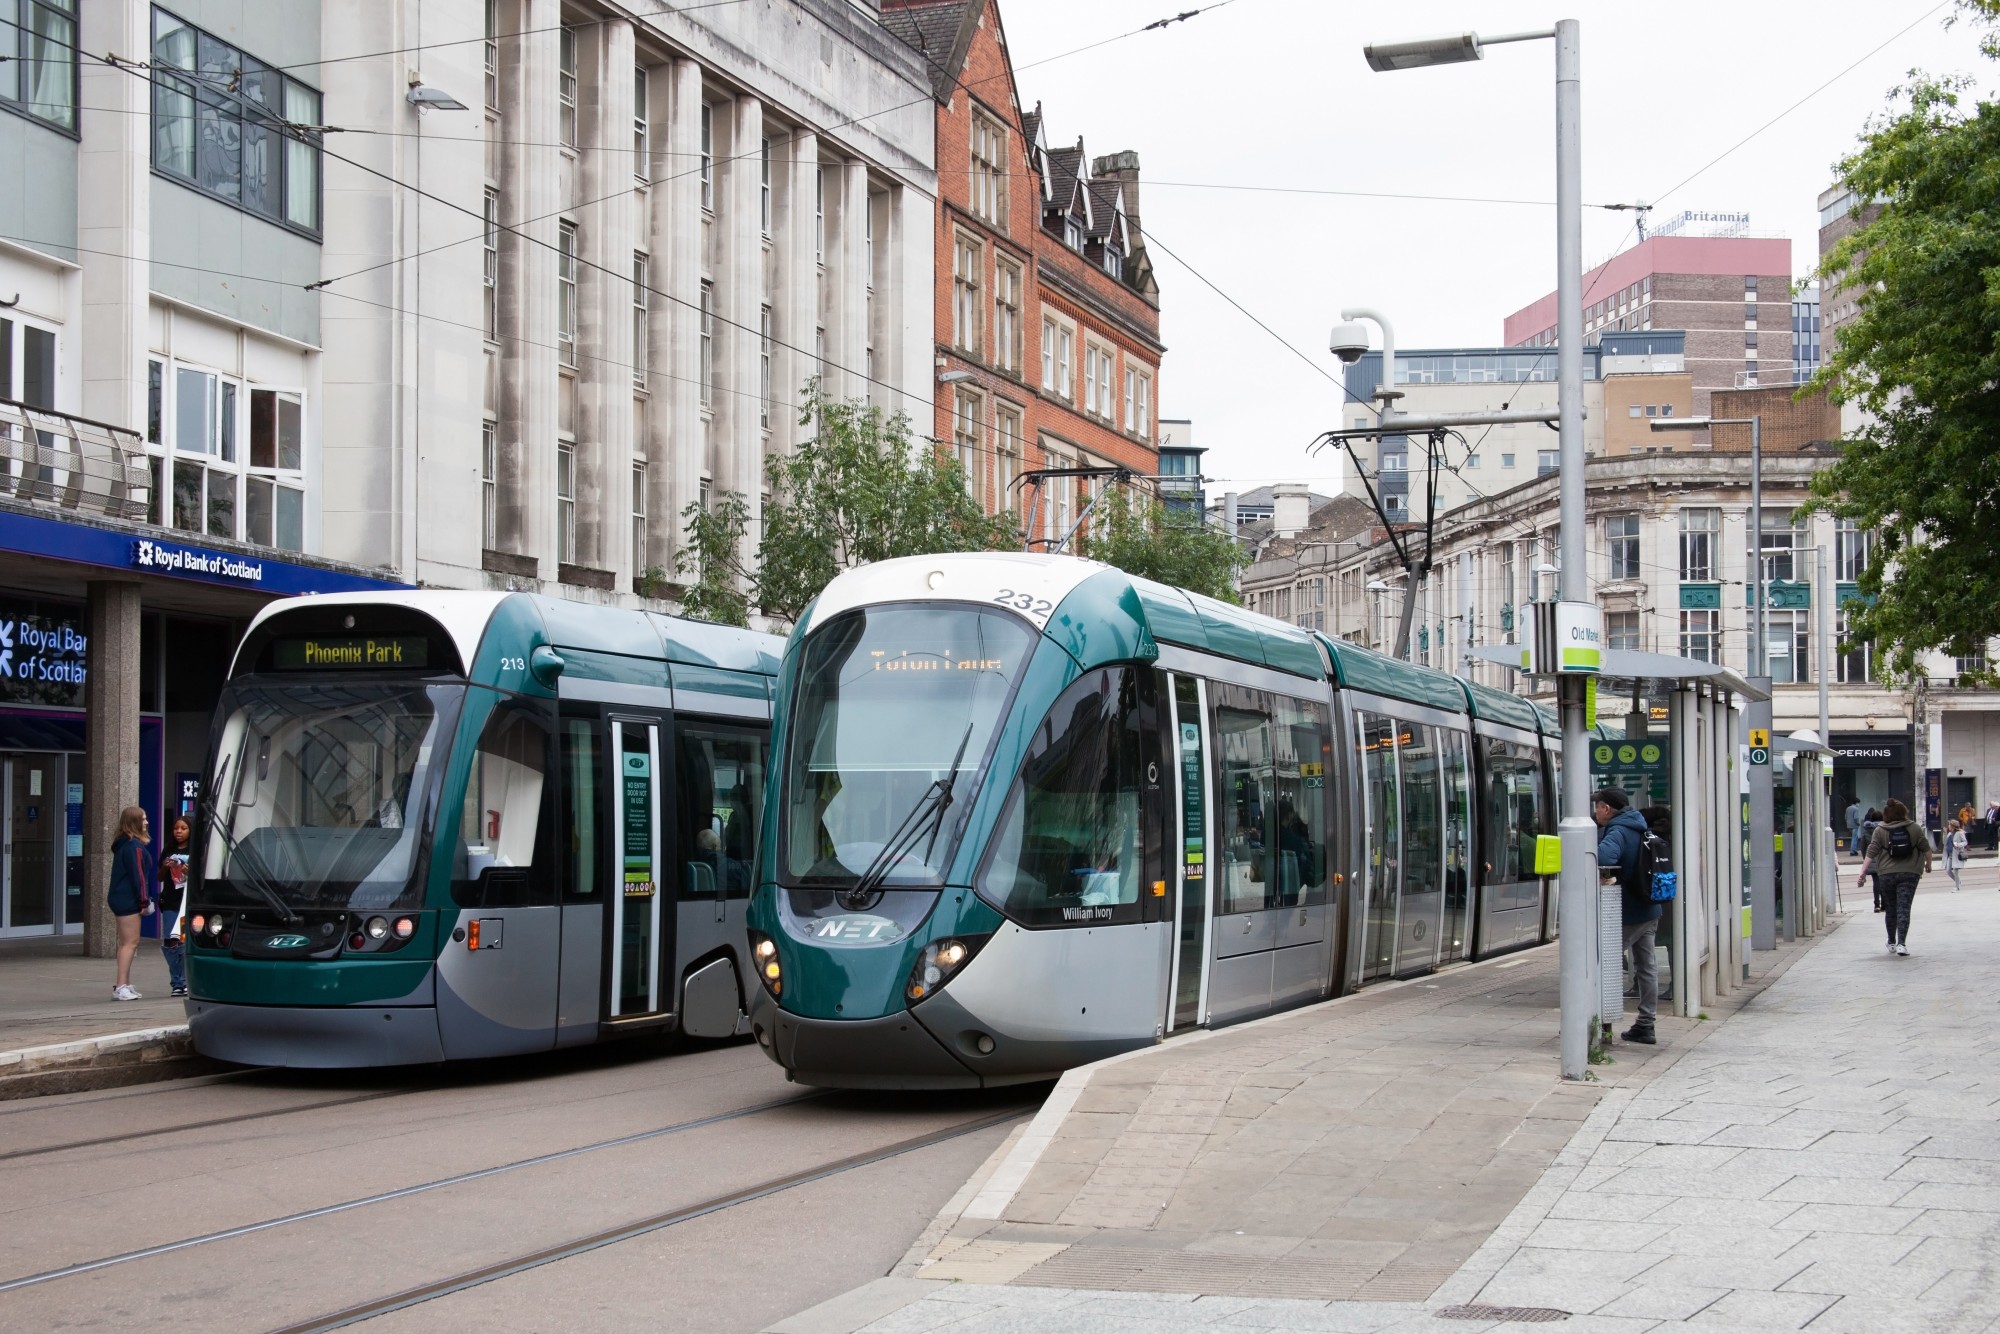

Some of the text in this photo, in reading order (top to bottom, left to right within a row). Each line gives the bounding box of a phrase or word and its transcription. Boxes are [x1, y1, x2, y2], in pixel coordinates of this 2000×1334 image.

[1684, 210, 1749, 223] Britannia
[155, 546, 262, 581] Royal Bank of Scotland
[994, 588, 1053, 618] 232
[20, 622, 61, 654] Royal
[1572, 626, 1585, 640] Old
[305, 640, 402, 664] Phoenix Park
[1144, 643, 1157, 656] 232
[19, 655, 37, 679] of
[501, 657, 525, 670] 213
[1838, 749, 1891, 757] PERKINS
[1062, 906, 1113, 920] William Ivory
[817, 920, 893, 938] NET
[267, 937, 305, 946] NET
